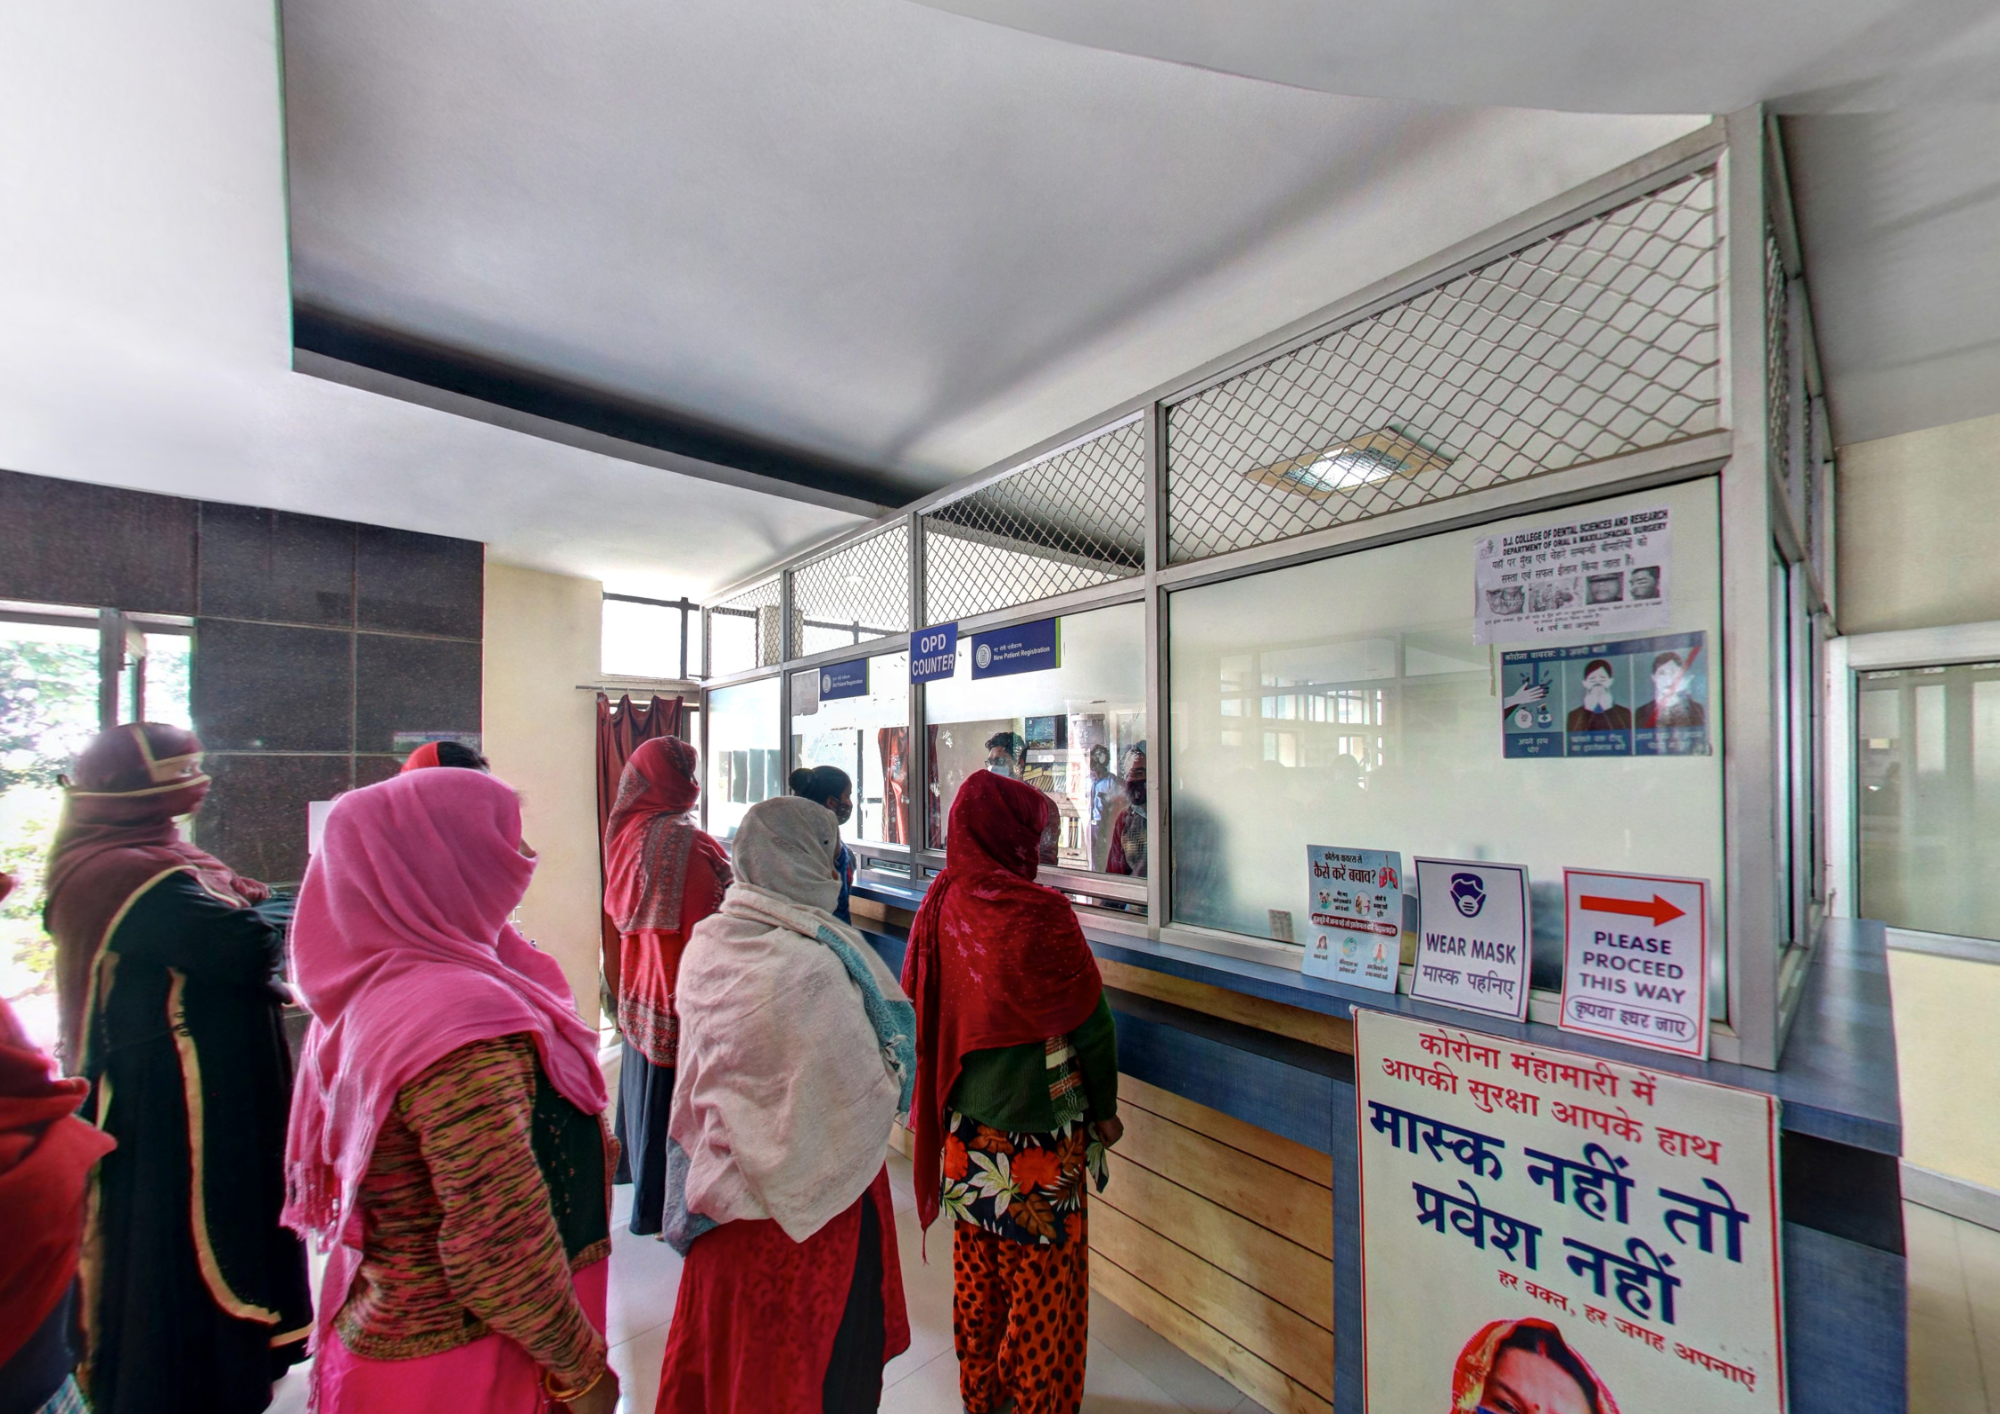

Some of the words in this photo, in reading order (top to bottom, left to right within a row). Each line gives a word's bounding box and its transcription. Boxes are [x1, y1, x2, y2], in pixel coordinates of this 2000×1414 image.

[1502, 537, 1514, 547] D.J.
[1514, 531, 1542, 544] COLLEGE
[1543, 529, 1552, 540] OF
[1552, 525, 1578, 538] DENTAL
[1579, 519, 1612, 533] SCIENCES
[1614, 516, 1628, 527] AND
[1630, 508, 1668, 524] RESEARCH
[1502, 542, 1542, 556] DEPARTMENT
[1543, 540, 1552, 549] OF
[1552, 538, 1571, 548] ORAL
[1579, 528, 1632, 543] MAXILLOFACIAL
[1632, 522, 1668, 534] SURGERY
[1501, 573, 1518, 584] सस्ता
[1535, 568, 1554, 579] सफल
[1506, 558, 1516, 568] पर
[921, 634, 946, 654] OPD
[1004, 650, 1020, 660] Patient
[1020, 646, 1050, 657] Registration
[1504, 652, 1528, 661] कोरोना
[912, 654, 954, 676] COUNTER
[1313, 860, 1330, 880] कैसे
[1331, 862, 1347, 882] करें
[1348, 868, 1377, 885] बचाव?
[1426, 932, 1466, 957] WEAR
[1470, 939, 1516, 965] MASK
[1594, 931, 1672, 955] PLEASE
[1583, 951, 1684, 980] PROCEED
[1422, 964, 1462, 986] मास्क
[1466, 969, 1516, 1000] पहनिए
[1579, 972, 1626, 994] THIS
[1634, 981, 1686, 1004] WAY
[1574, 1001, 1616, 1019] कृपया
[1654, 1016, 1688, 1038] जाए
[1418, 1028, 1500, 1070] कोरोना
[1631, 1072, 1658, 1106] में
[1382, 1057, 1458, 1095] आपकी
[1468, 1078, 1540, 1118] सुरक्षा
[1551, 1101, 1644, 1144] आपके
[1656, 1126, 1722, 1166] हाथ
[1368, 1100, 1506, 1181] मास्क
[1524, 1142, 1636, 1224] नहीं
[1658, 1177, 1750, 1264] तो
[1412, 1179, 1543, 1271] प्रवेश
[1563, 1236, 1682, 1325] नहीं
[1498, 1269, 1518, 1290] हर
[1524, 1280, 1576, 1317] वक्त,
[1583, 1303, 1608, 1328] हर
[1614, 1316, 1666, 1352] जगह
[1673, 1342, 1757, 1393] अपनाएं
